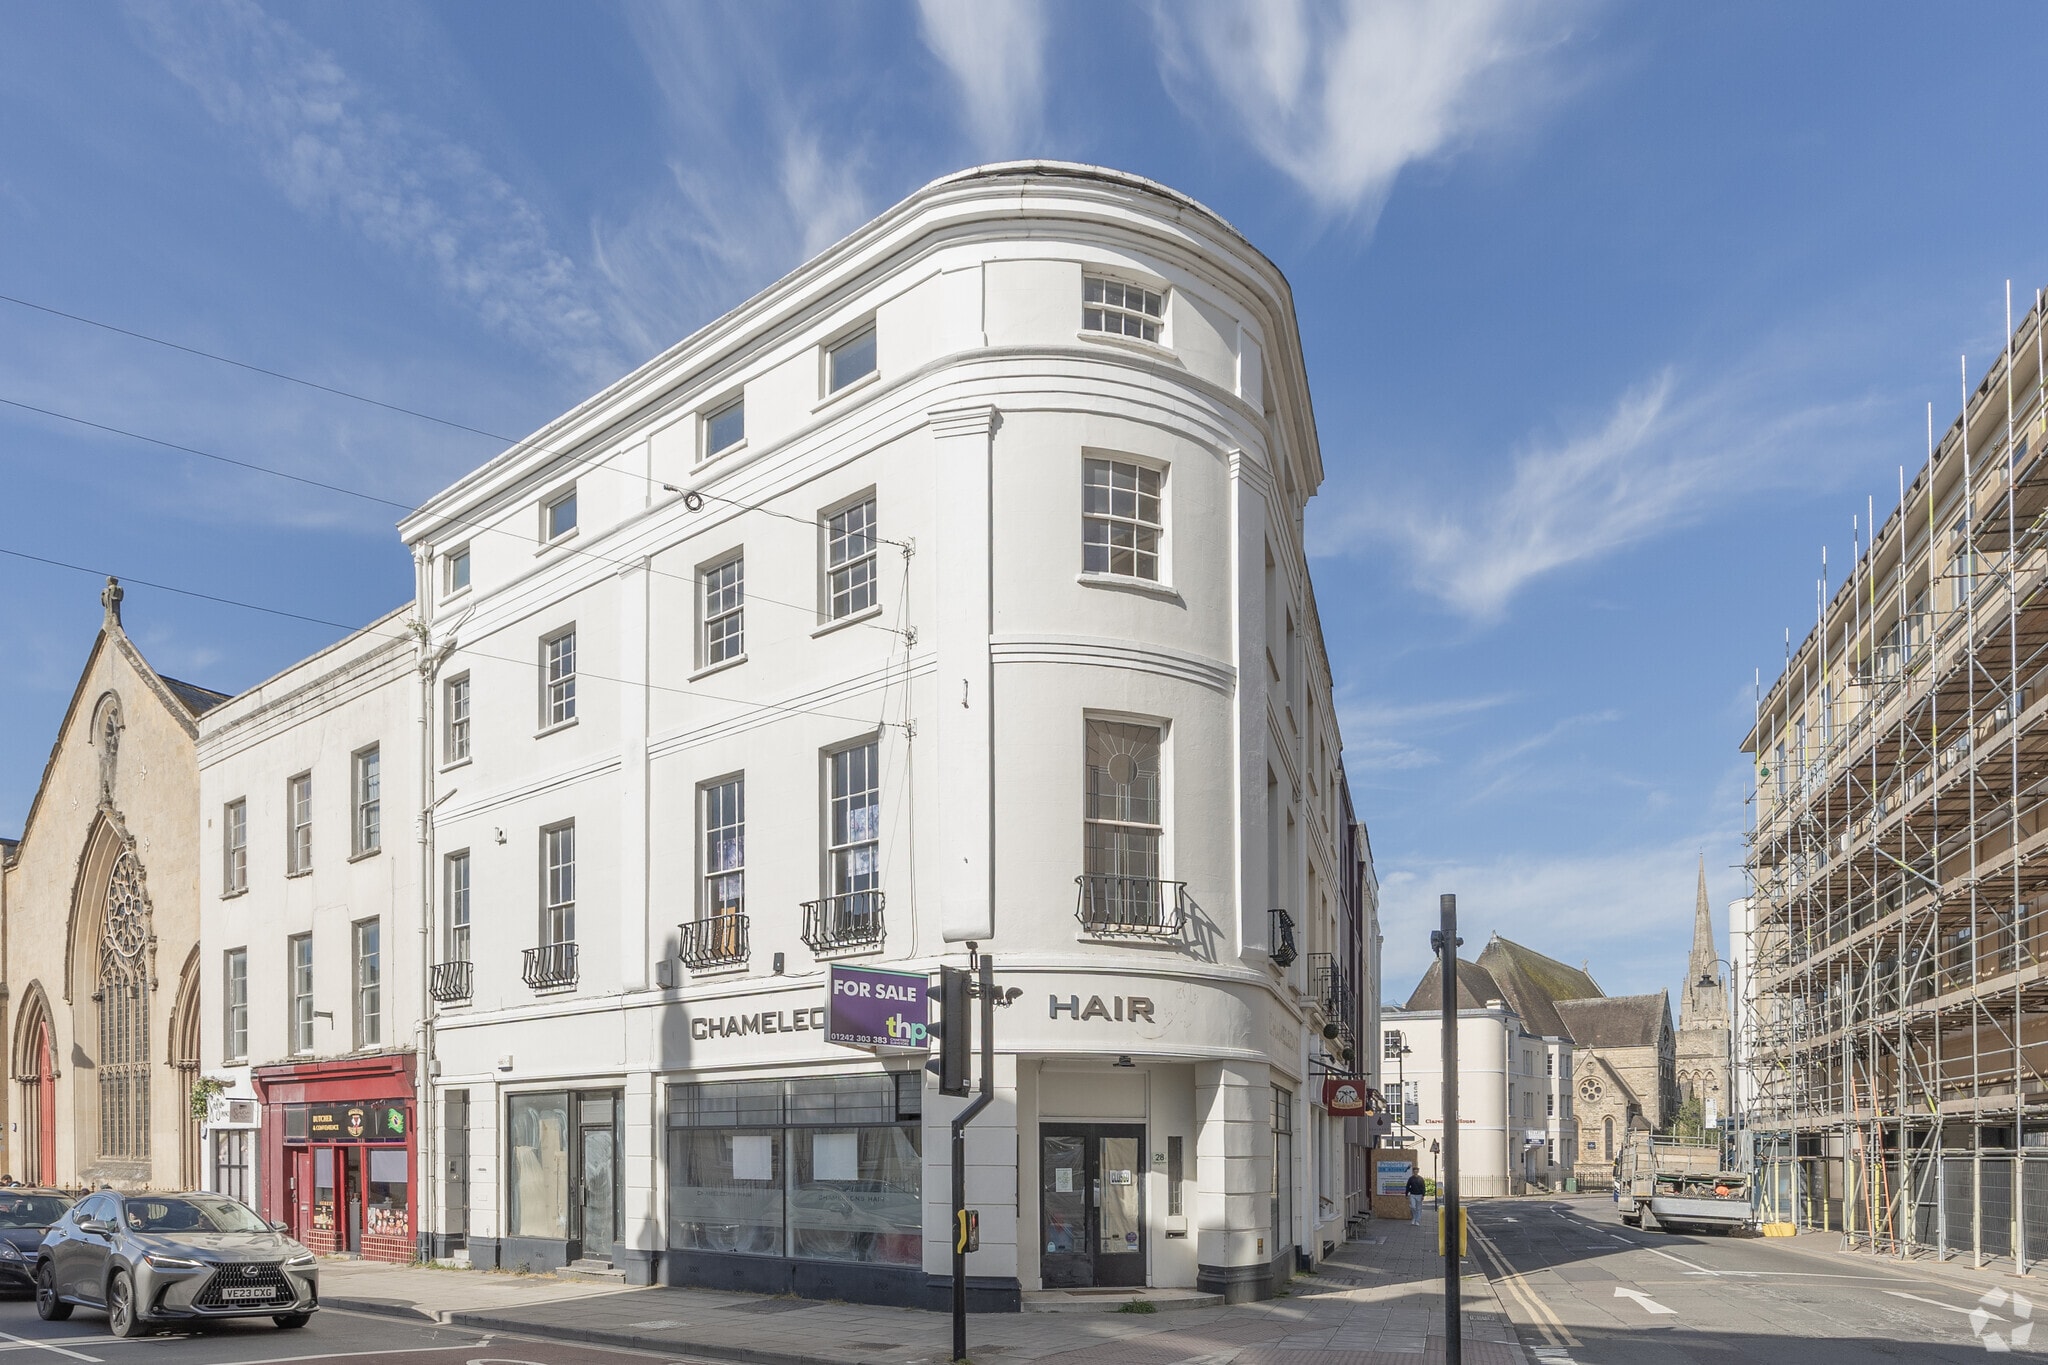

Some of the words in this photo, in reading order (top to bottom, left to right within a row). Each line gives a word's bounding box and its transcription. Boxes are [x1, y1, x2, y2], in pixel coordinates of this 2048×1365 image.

[833, 979, 871, 998] FOR
[875, 983, 917, 1002] SALE
[1049, 994, 1156, 1024] HAIR
[885, 1013, 927, 1046] thp
[831, 1033, 854, 1041] 01242
[856, 1034, 871, 1042] 303
[873, 1036, 887, 1044] 383
[1155, 1153, 1165, 1161] 28
[227, 1289, 252, 1298] VE23
[253, 1288, 272, 1297] CXG
